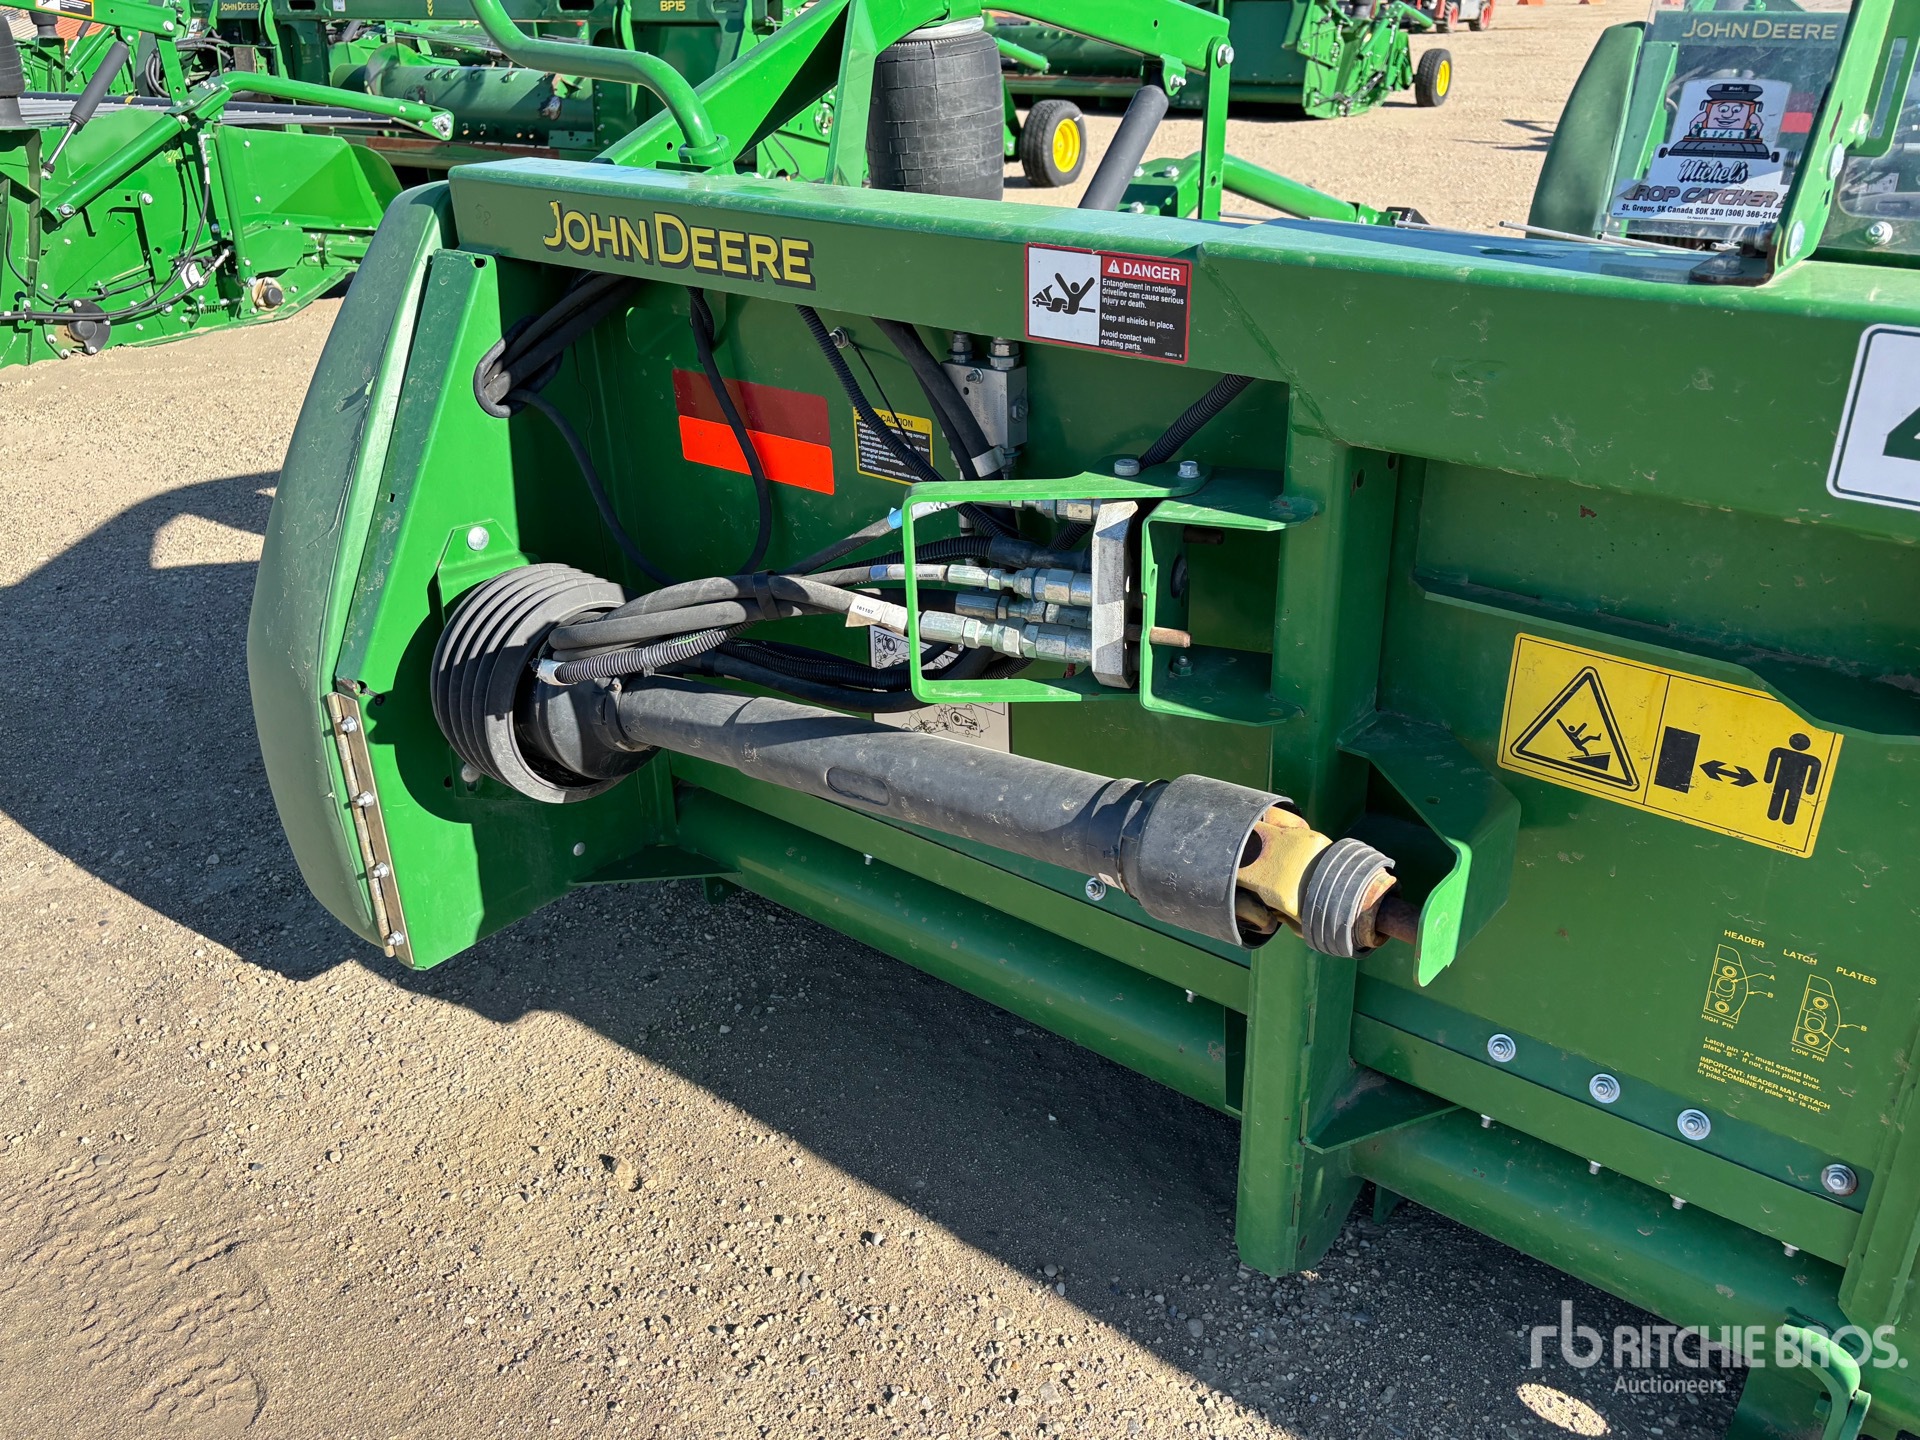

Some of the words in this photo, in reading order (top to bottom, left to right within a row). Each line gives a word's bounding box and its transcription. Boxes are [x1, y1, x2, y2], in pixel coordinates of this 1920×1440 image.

[220, 2, 237, 11] JOHN
[237, 2, 259, 10] DEERE
[660, 0, 686, 12] BP15
[1682, 19, 1749, 38] JOHN
[1752, 20, 1838, 40] DEERE
[1678, 159, 1748, 184] Michel's
[1681, 187, 1778, 208] CATCHER
[1668, 206, 1693, 214] Canada
[543, 200, 652, 264] JOHN
[654, 212, 816, 290] DEERE
[1123, 262, 1180, 281] DANGER
[1102, 278, 1143, 290] Entanglement
[1152, 284, 1176, 296] rotating
[1102, 288, 1127, 297] driveline
[1141, 293, 1159, 301] cause
[1161, 295, 1184, 304] serious
[1102, 296, 1118, 306] injury
[1128, 300, 1146, 309] death.
[1102, 313, 1116, 322] Keep
[1127, 317, 1148, 326] shields
[1157, 321, 1175, 330] place.
[1101, 339, 1123, 349] rotating
[1125, 343, 1142, 351] parts.
[1102, 329, 1118, 338] Avoid
[1120, 333, 1142, 342] contact
[1143, 336, 1156, 344] with
[880, 414, 913, 428] CAUION
[1724, 930, 1766, 948] HEADER
[1783, 949, 1818, 966] LATCH
[1836, 966, 1877, 985] PLATES
[1702, 1014, 1719, 1024] HIGH
[1722, 1021, 1734, 1029] PIN
[1705, 1036, 1725, 1049] Latch
[1755, 1056, 1774, 1066] must
[1776, 1063, 1801, 1077] extend
[1803, 1073, 1819, 1083] thru
[1791, 1047, 1808, 1057] LOW
[1812, 1054, 1825, 1063] PIN
[1703, 1043, 1721, 1054] plate
[1749, 1060, 1763, 1070] not,
[1765, 1066, 1780, 1076] turn
[1782, 1072, 1800, 1084] plate
[1802, 1081, 1822, 1092] over.
[1700, 1056, 1745, 1077] IMPORTANT:
[1747, 1074, 1779, 1090] HEADER
[1780, 1086, 1797, 1097] MAY
[1798, 1094, 1831, 1110] DETACH
[1706, 1071, 1727, 1084] place.
[1699, 1062, 1721, 1075] FROM
[1722, 1071, 1758, 1089] COMBINE
[1765, 1087, 1783, 1099] plate
[1807, 1104, 1821, 1113] not
